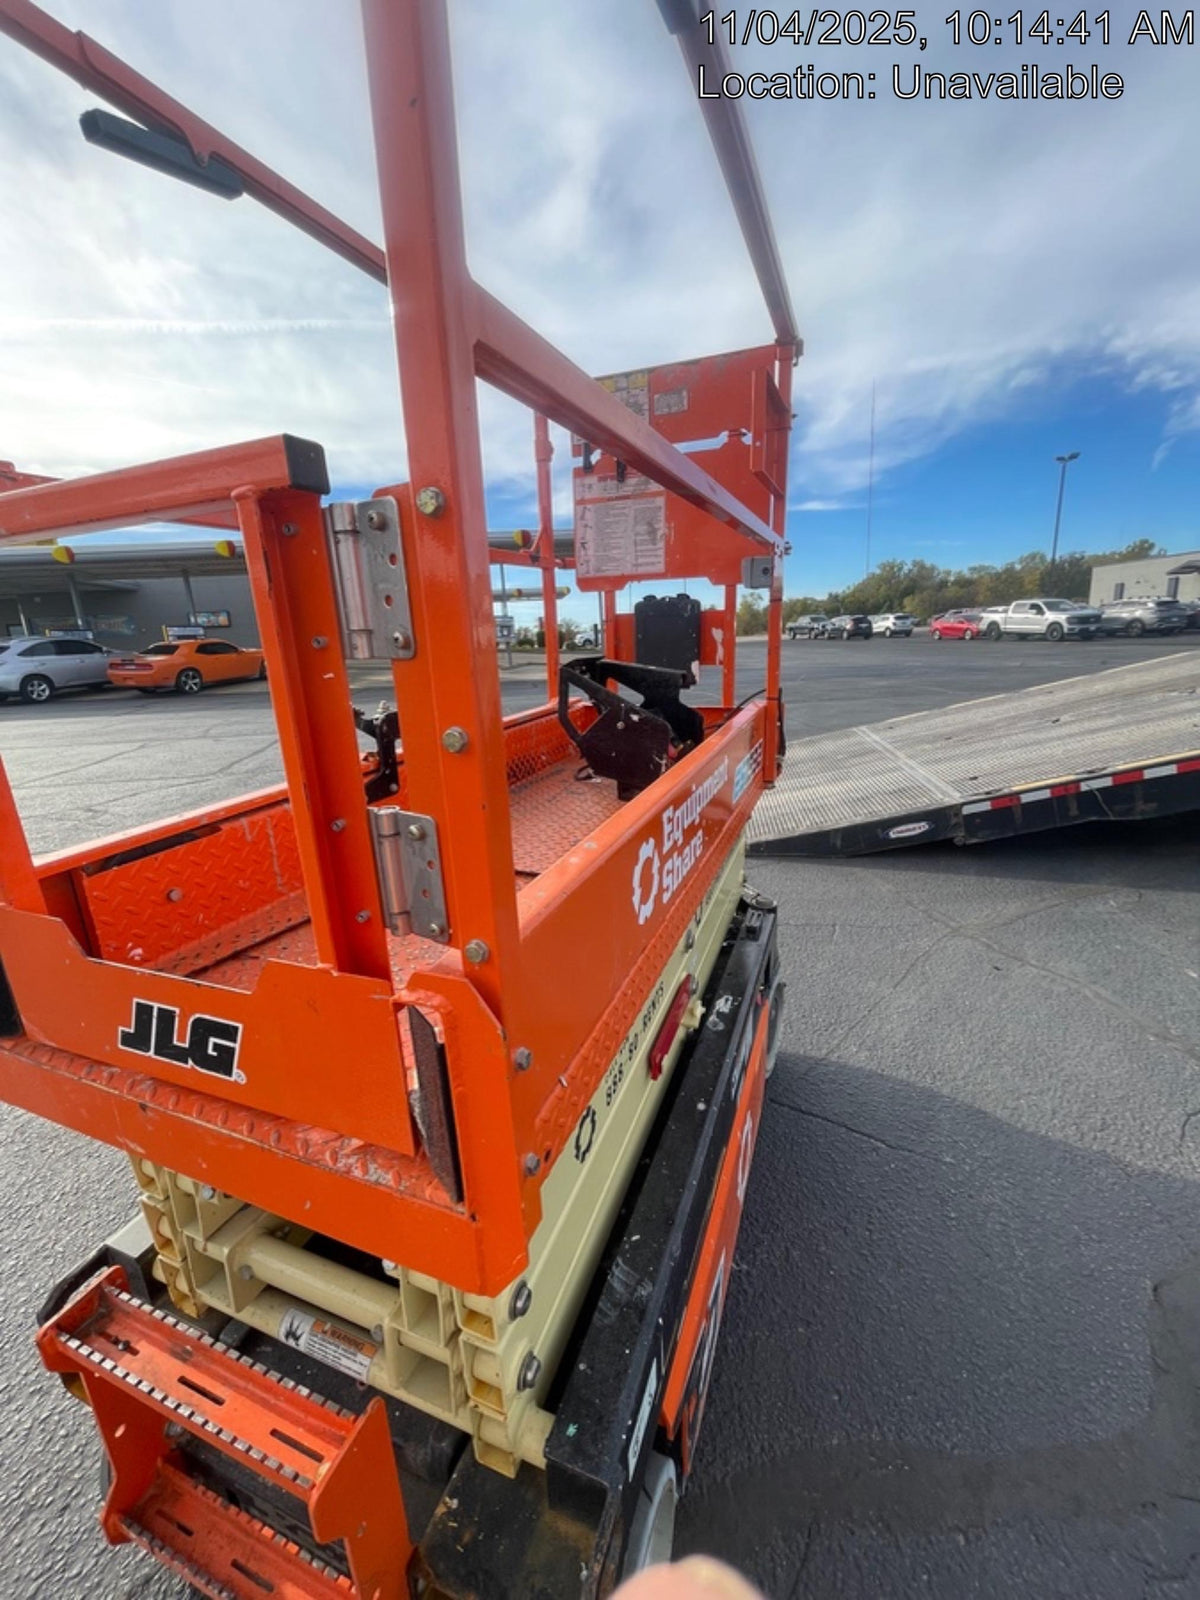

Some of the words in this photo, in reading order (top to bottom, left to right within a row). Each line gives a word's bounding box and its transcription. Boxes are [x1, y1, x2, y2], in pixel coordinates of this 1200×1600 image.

[662, 755, 728, 855] Equipment
[662, 828, 703, 904] Share
[118, 998, 243, 1082] JLG
